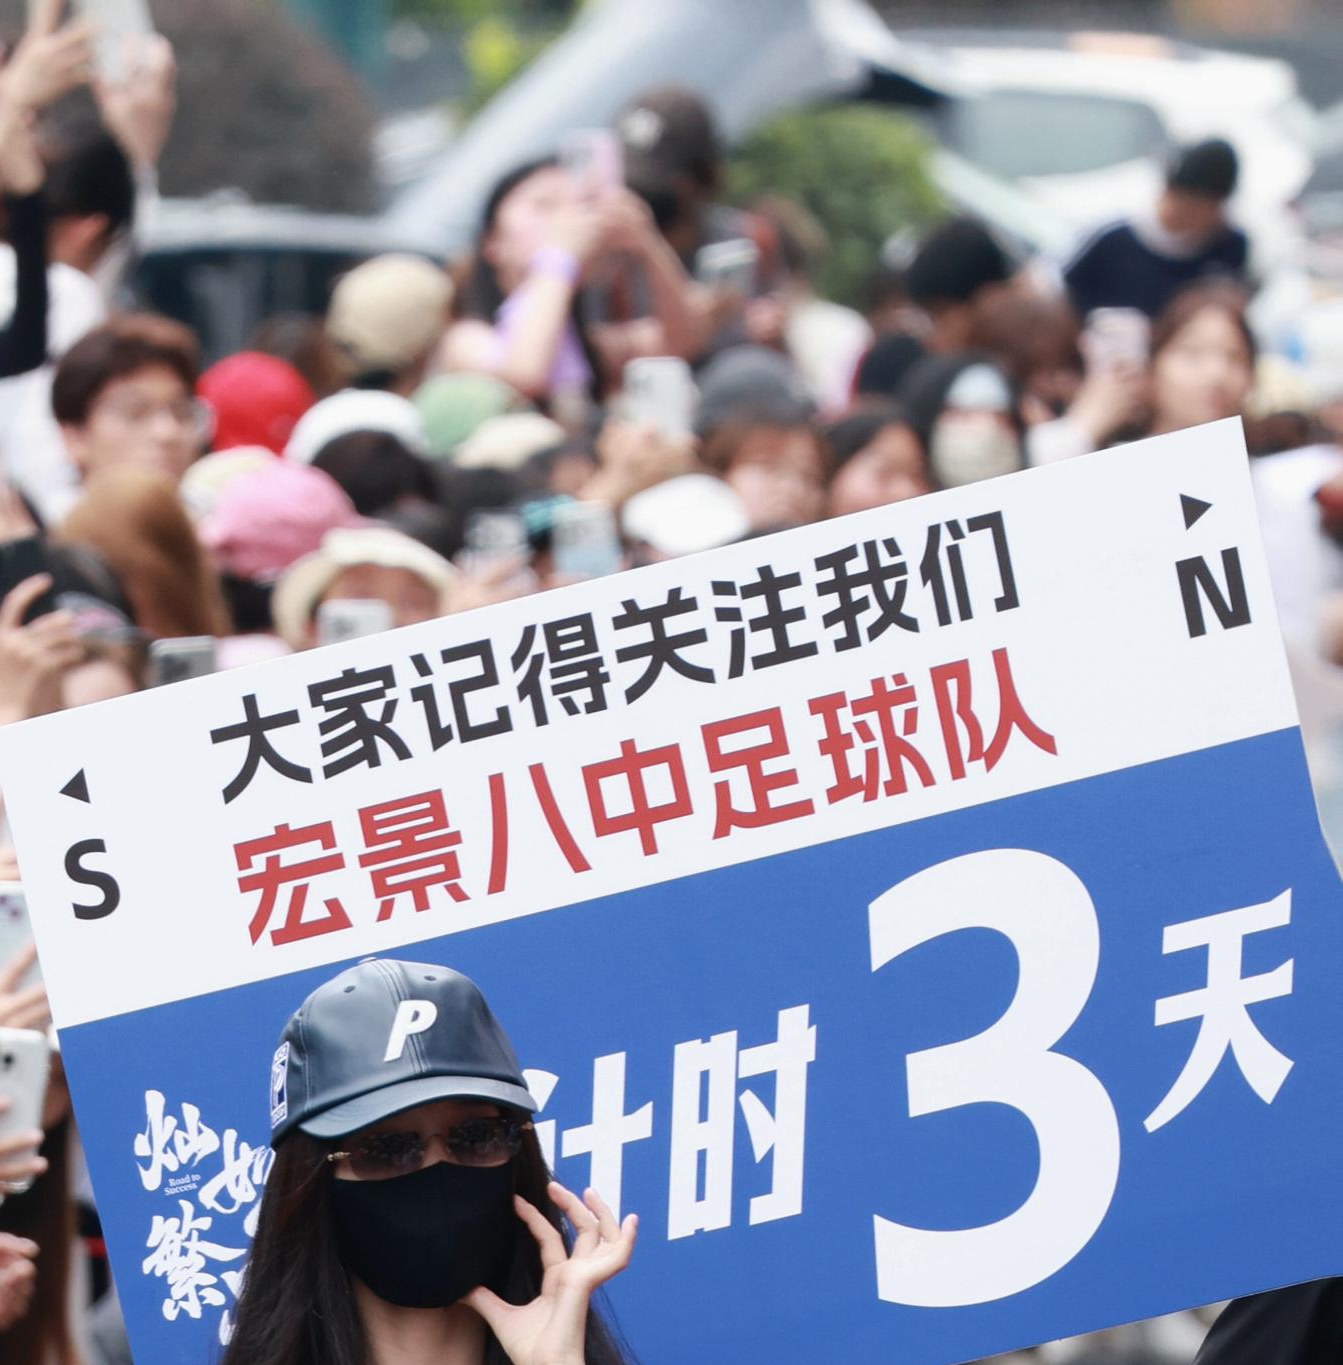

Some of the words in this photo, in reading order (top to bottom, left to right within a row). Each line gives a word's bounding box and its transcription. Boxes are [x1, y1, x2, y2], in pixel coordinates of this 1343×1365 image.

[1175, 546, 1252, 639] N
[211, 511, 1021, 805] 大家记得关注我们
[233, 648, 1058, 947] 宏景八中足球队
[64, 838, 120, 920] S
[384, 1000, 437, 1062] P
